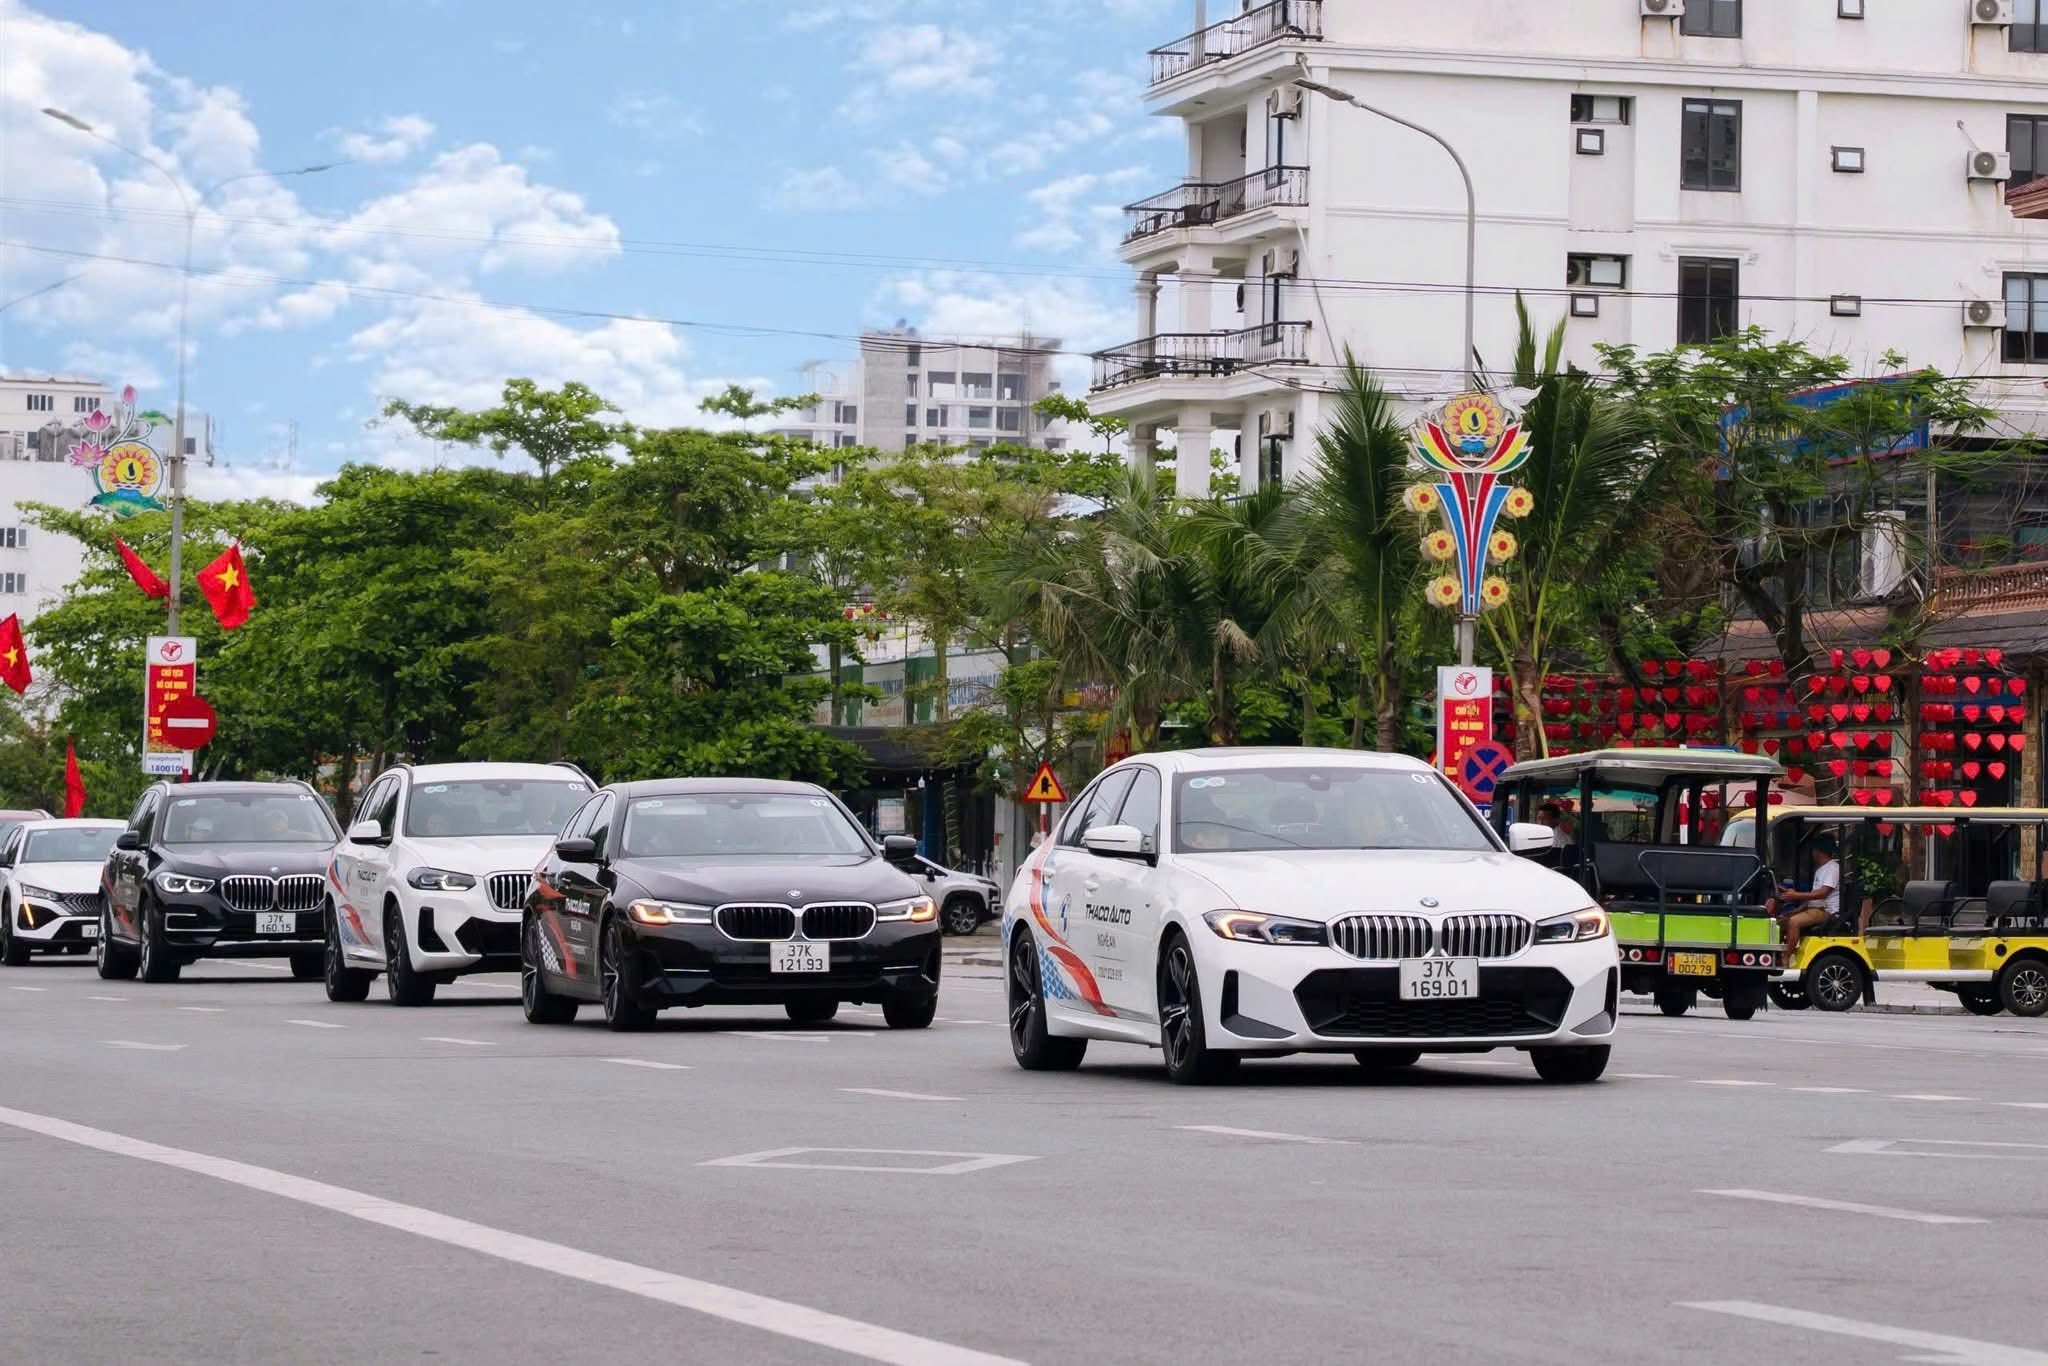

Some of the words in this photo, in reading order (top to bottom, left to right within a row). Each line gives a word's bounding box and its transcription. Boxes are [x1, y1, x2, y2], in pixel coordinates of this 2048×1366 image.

[1411, 773, 1437, 784] 01
[810, 799, 831, 807] 02
[268, 914, 284, 923] 37K
[262, 924, 292, 932] 160.15
[788, 945, 812, 957] 37K
[780, 958, 823, 971] 121.93
[1423, 961, 1455, 977] 37K
[1678, 964, 1712, 975] 002.79
[1411, 979, 1468, 997] 169.01
